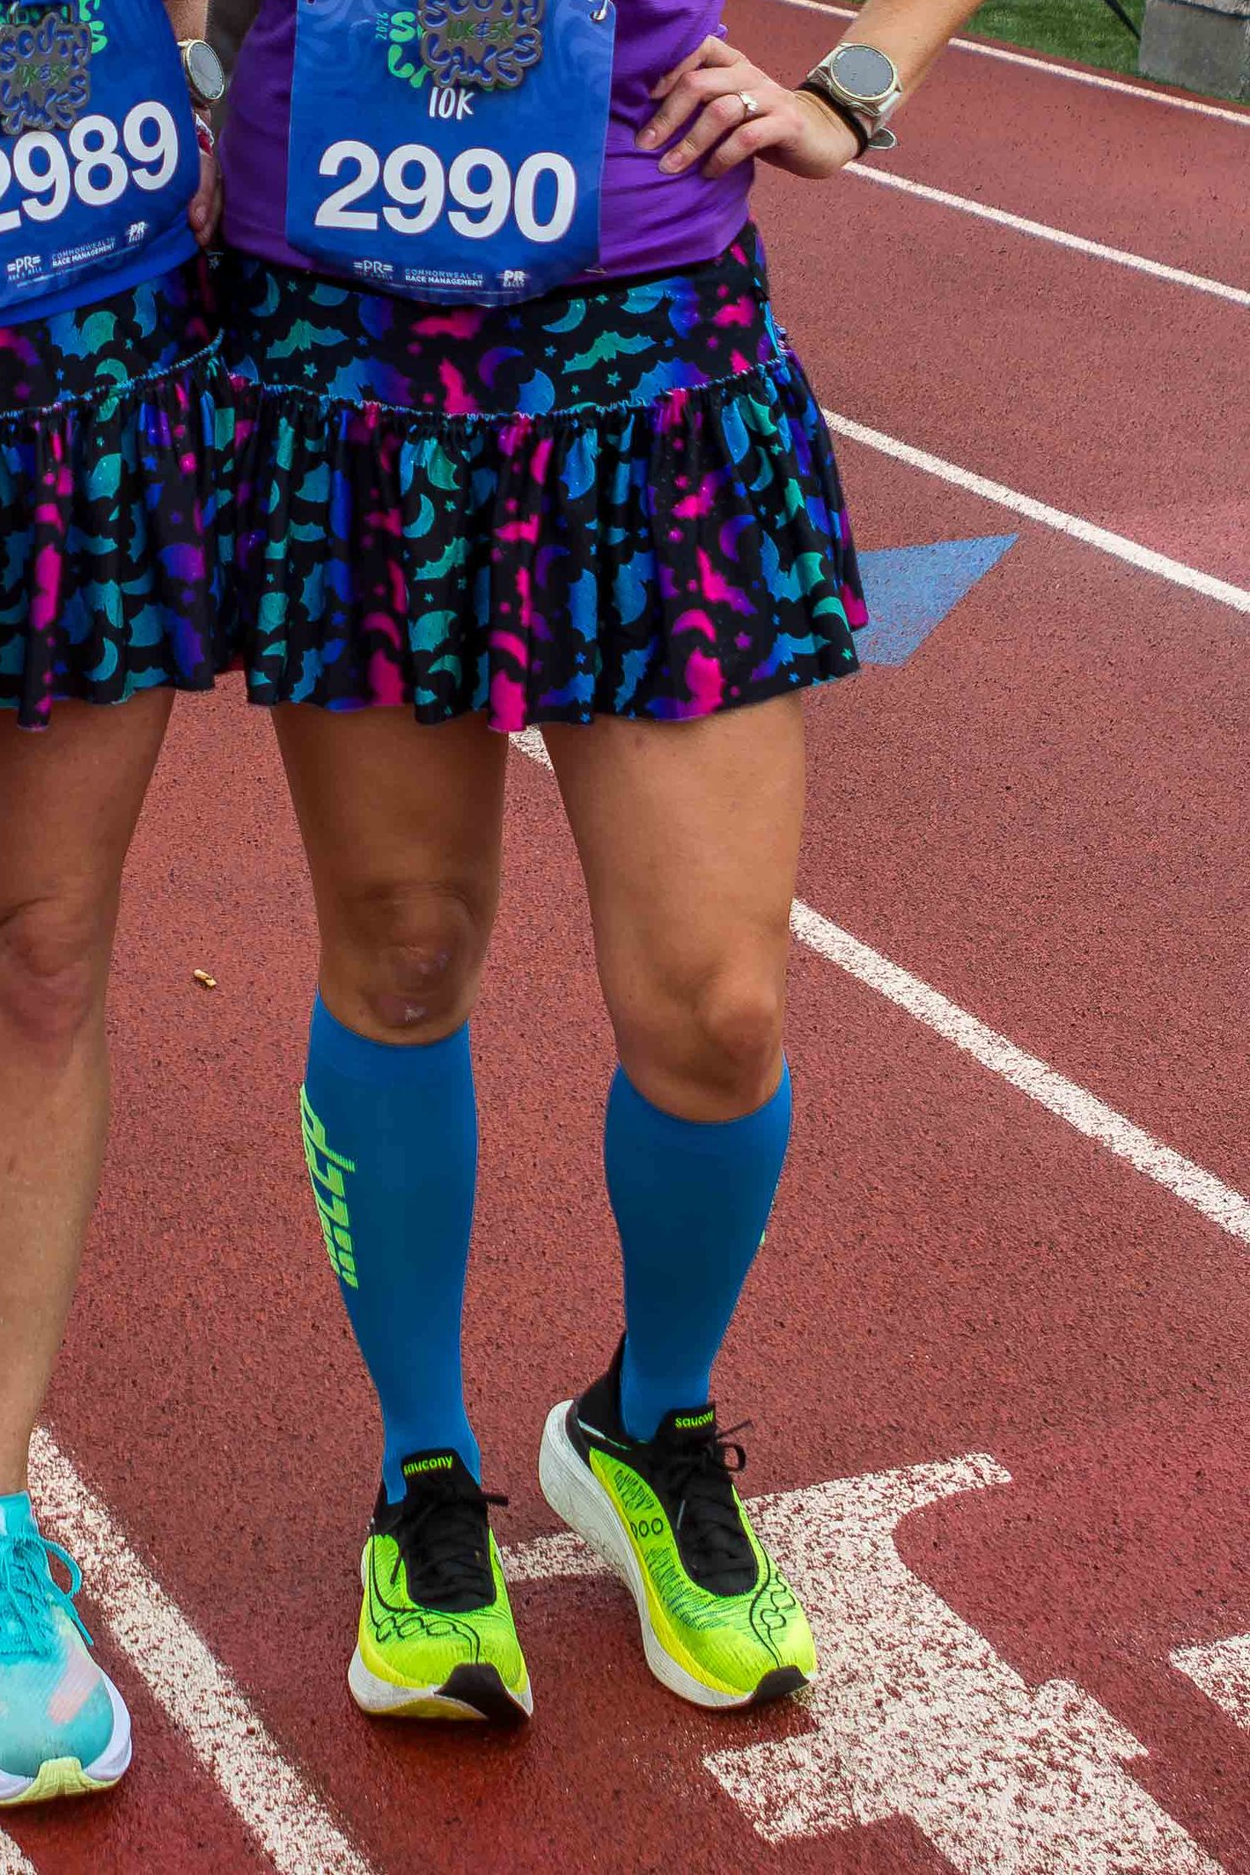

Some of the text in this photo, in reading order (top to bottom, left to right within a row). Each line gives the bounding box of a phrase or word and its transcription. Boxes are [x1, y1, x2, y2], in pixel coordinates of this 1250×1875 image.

[428, 86, 475, 120] 10K
[314, 140, 577, 243] 2990
[52, 242, 115, 267] RACE MANAGEMENT
[405, 275, 483, 287] RACE MANAGEMENT
[504, 270, 525, 282] PR
